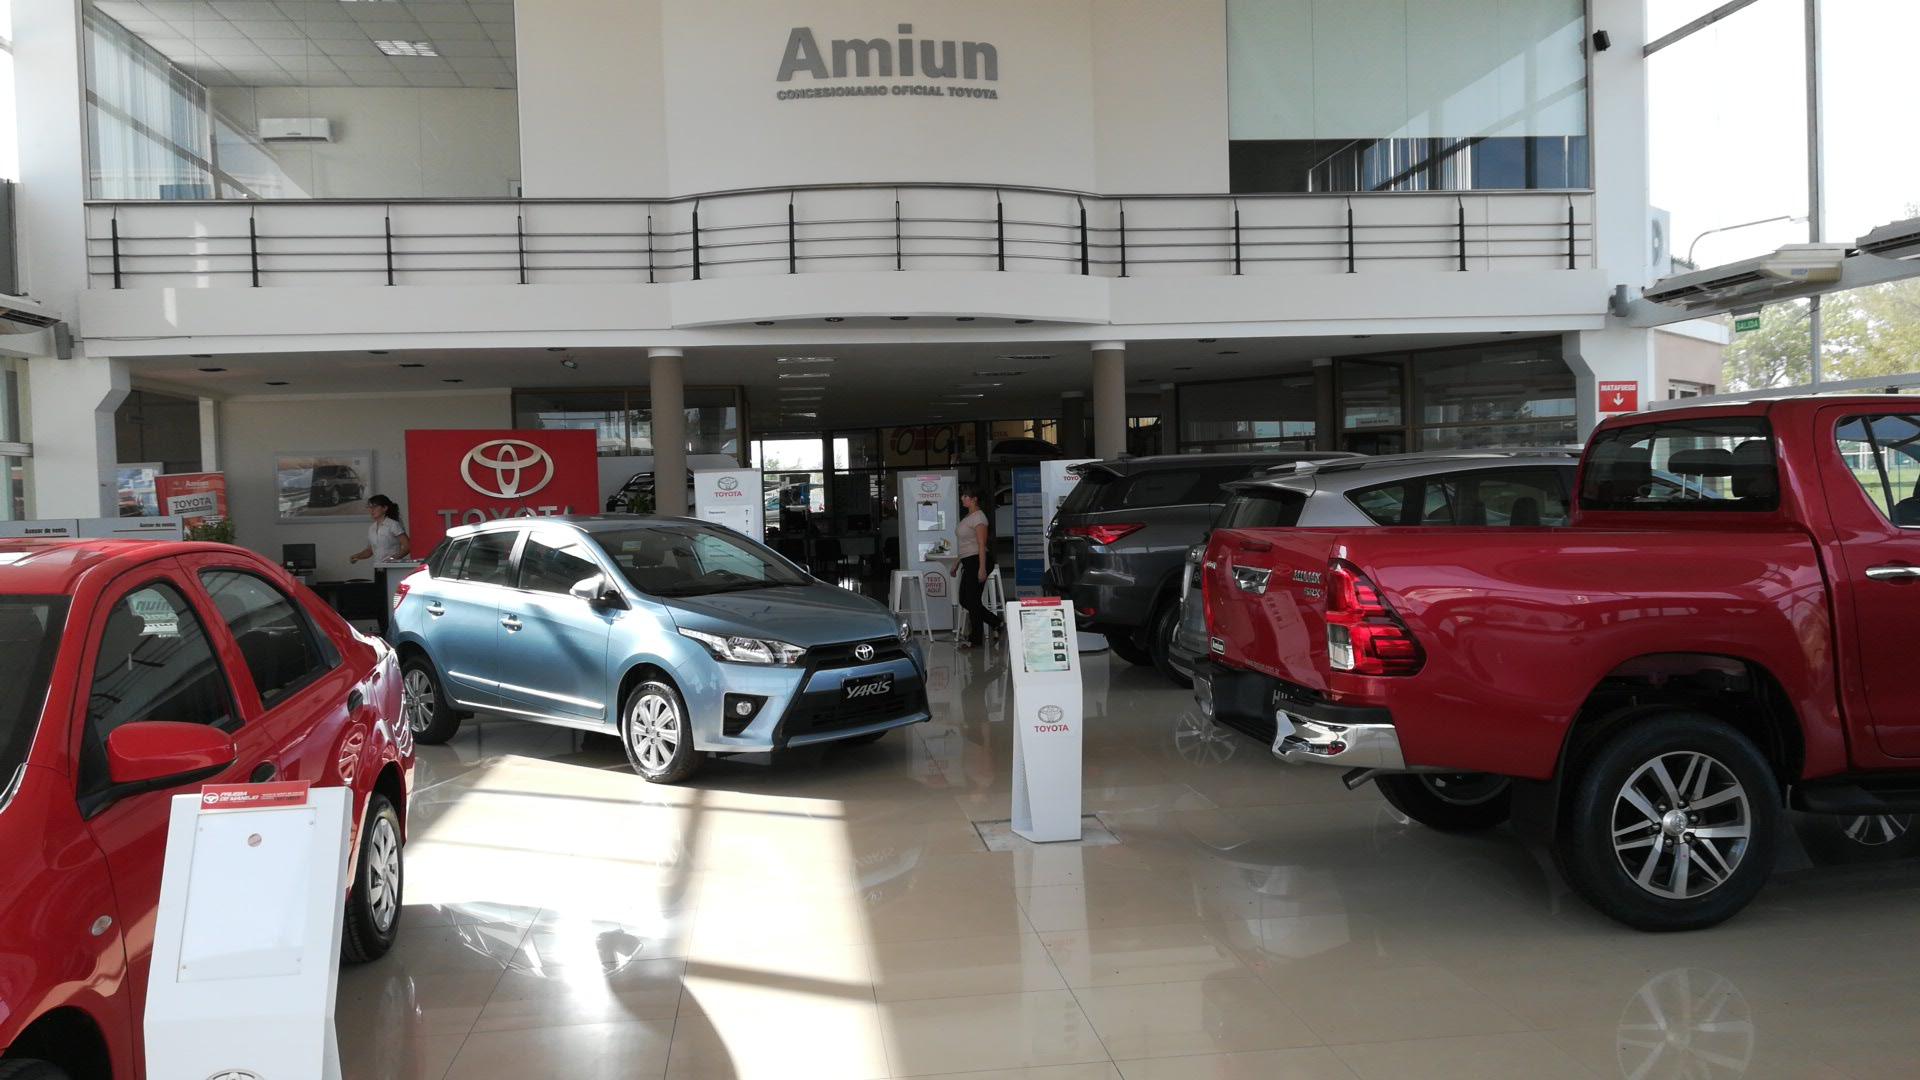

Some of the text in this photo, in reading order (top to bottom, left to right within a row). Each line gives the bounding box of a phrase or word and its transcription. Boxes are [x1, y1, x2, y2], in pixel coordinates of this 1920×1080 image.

[776, 23, 998, 81] Amiun
[777, 85, 998, 100] CONCESIONARIO OFICIAL TOYOTA
[714, 490, 743, 498] TOYOTA
[173, 497, 212, 509] TOYOTA
[846, 680, 892, 699] YARIS
[1034, 724, 1069, 732] TOYOTA
